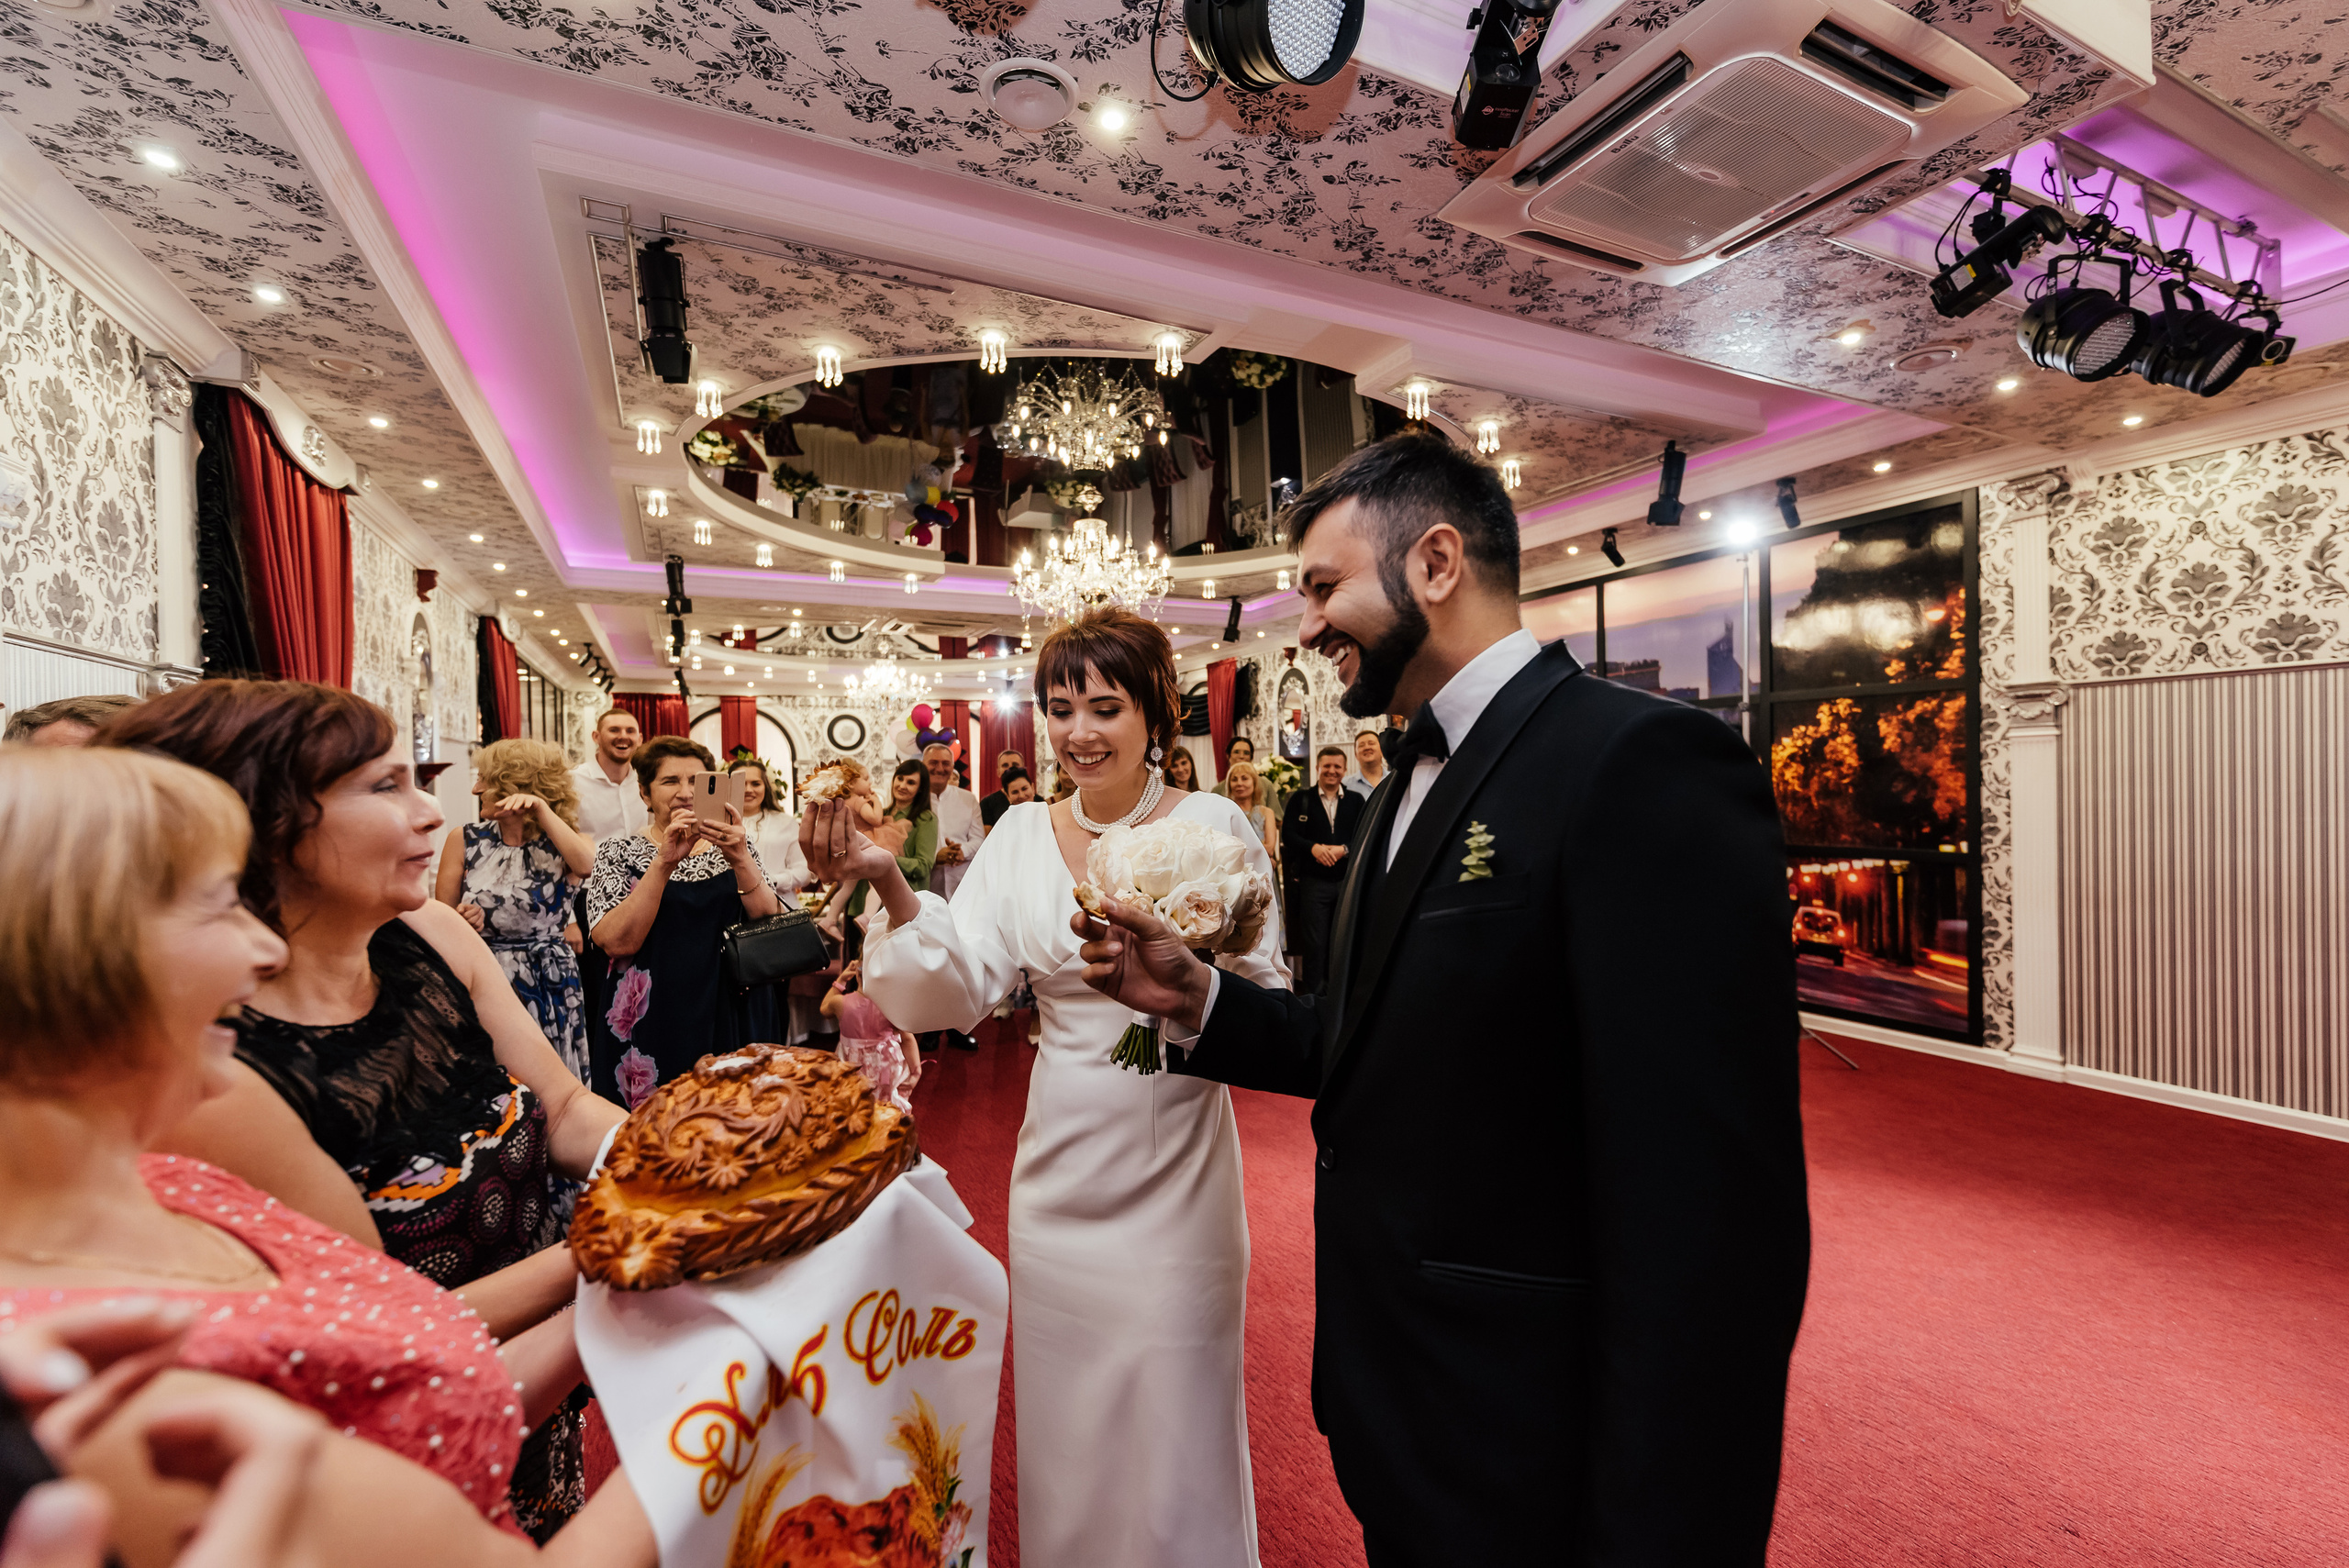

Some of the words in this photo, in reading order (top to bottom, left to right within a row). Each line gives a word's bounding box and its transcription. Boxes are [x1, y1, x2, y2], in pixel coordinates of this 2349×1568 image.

[1610, 135, 1640, 154] Ballu
[668, 1323, 829, 1516] Хлб
[843, 1287, 978, 1386] Соль
